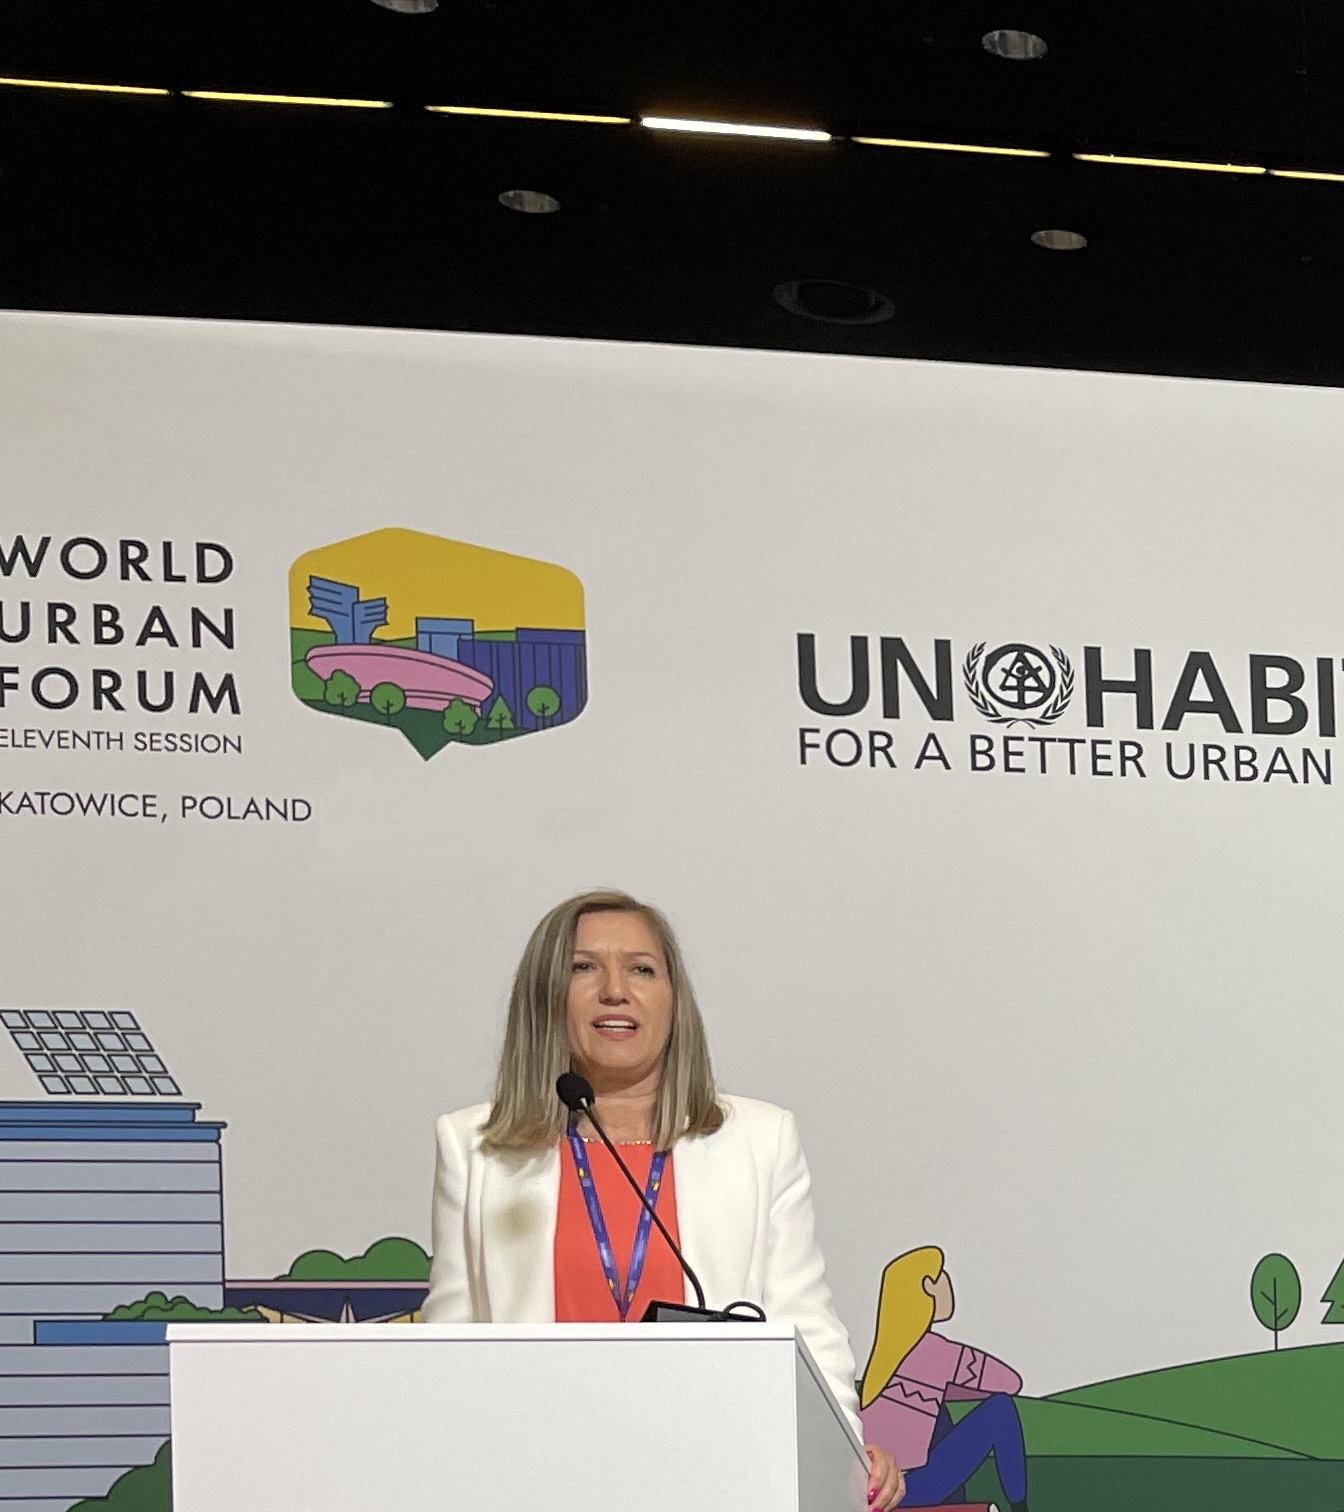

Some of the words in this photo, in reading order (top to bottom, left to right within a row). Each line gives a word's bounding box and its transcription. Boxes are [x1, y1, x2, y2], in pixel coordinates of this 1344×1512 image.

[0, 534, 234, 584] WORLD
[0, 600, 235, 650] URBAN
[0, 665, 241, 716] FORUM
[796, 632, 955, 722] UN
[133, 731, 242, 754] SESSION
[798, 727, 898, 769] FOR
[914, 732, 952, 771] A
[969, 734, 1147, 778] BETTER
[1165, 741, 1332, 785] URBAN
[0, 791, 167, 824] KATOWICE,
[181, 795, 312, 822] POLAND
